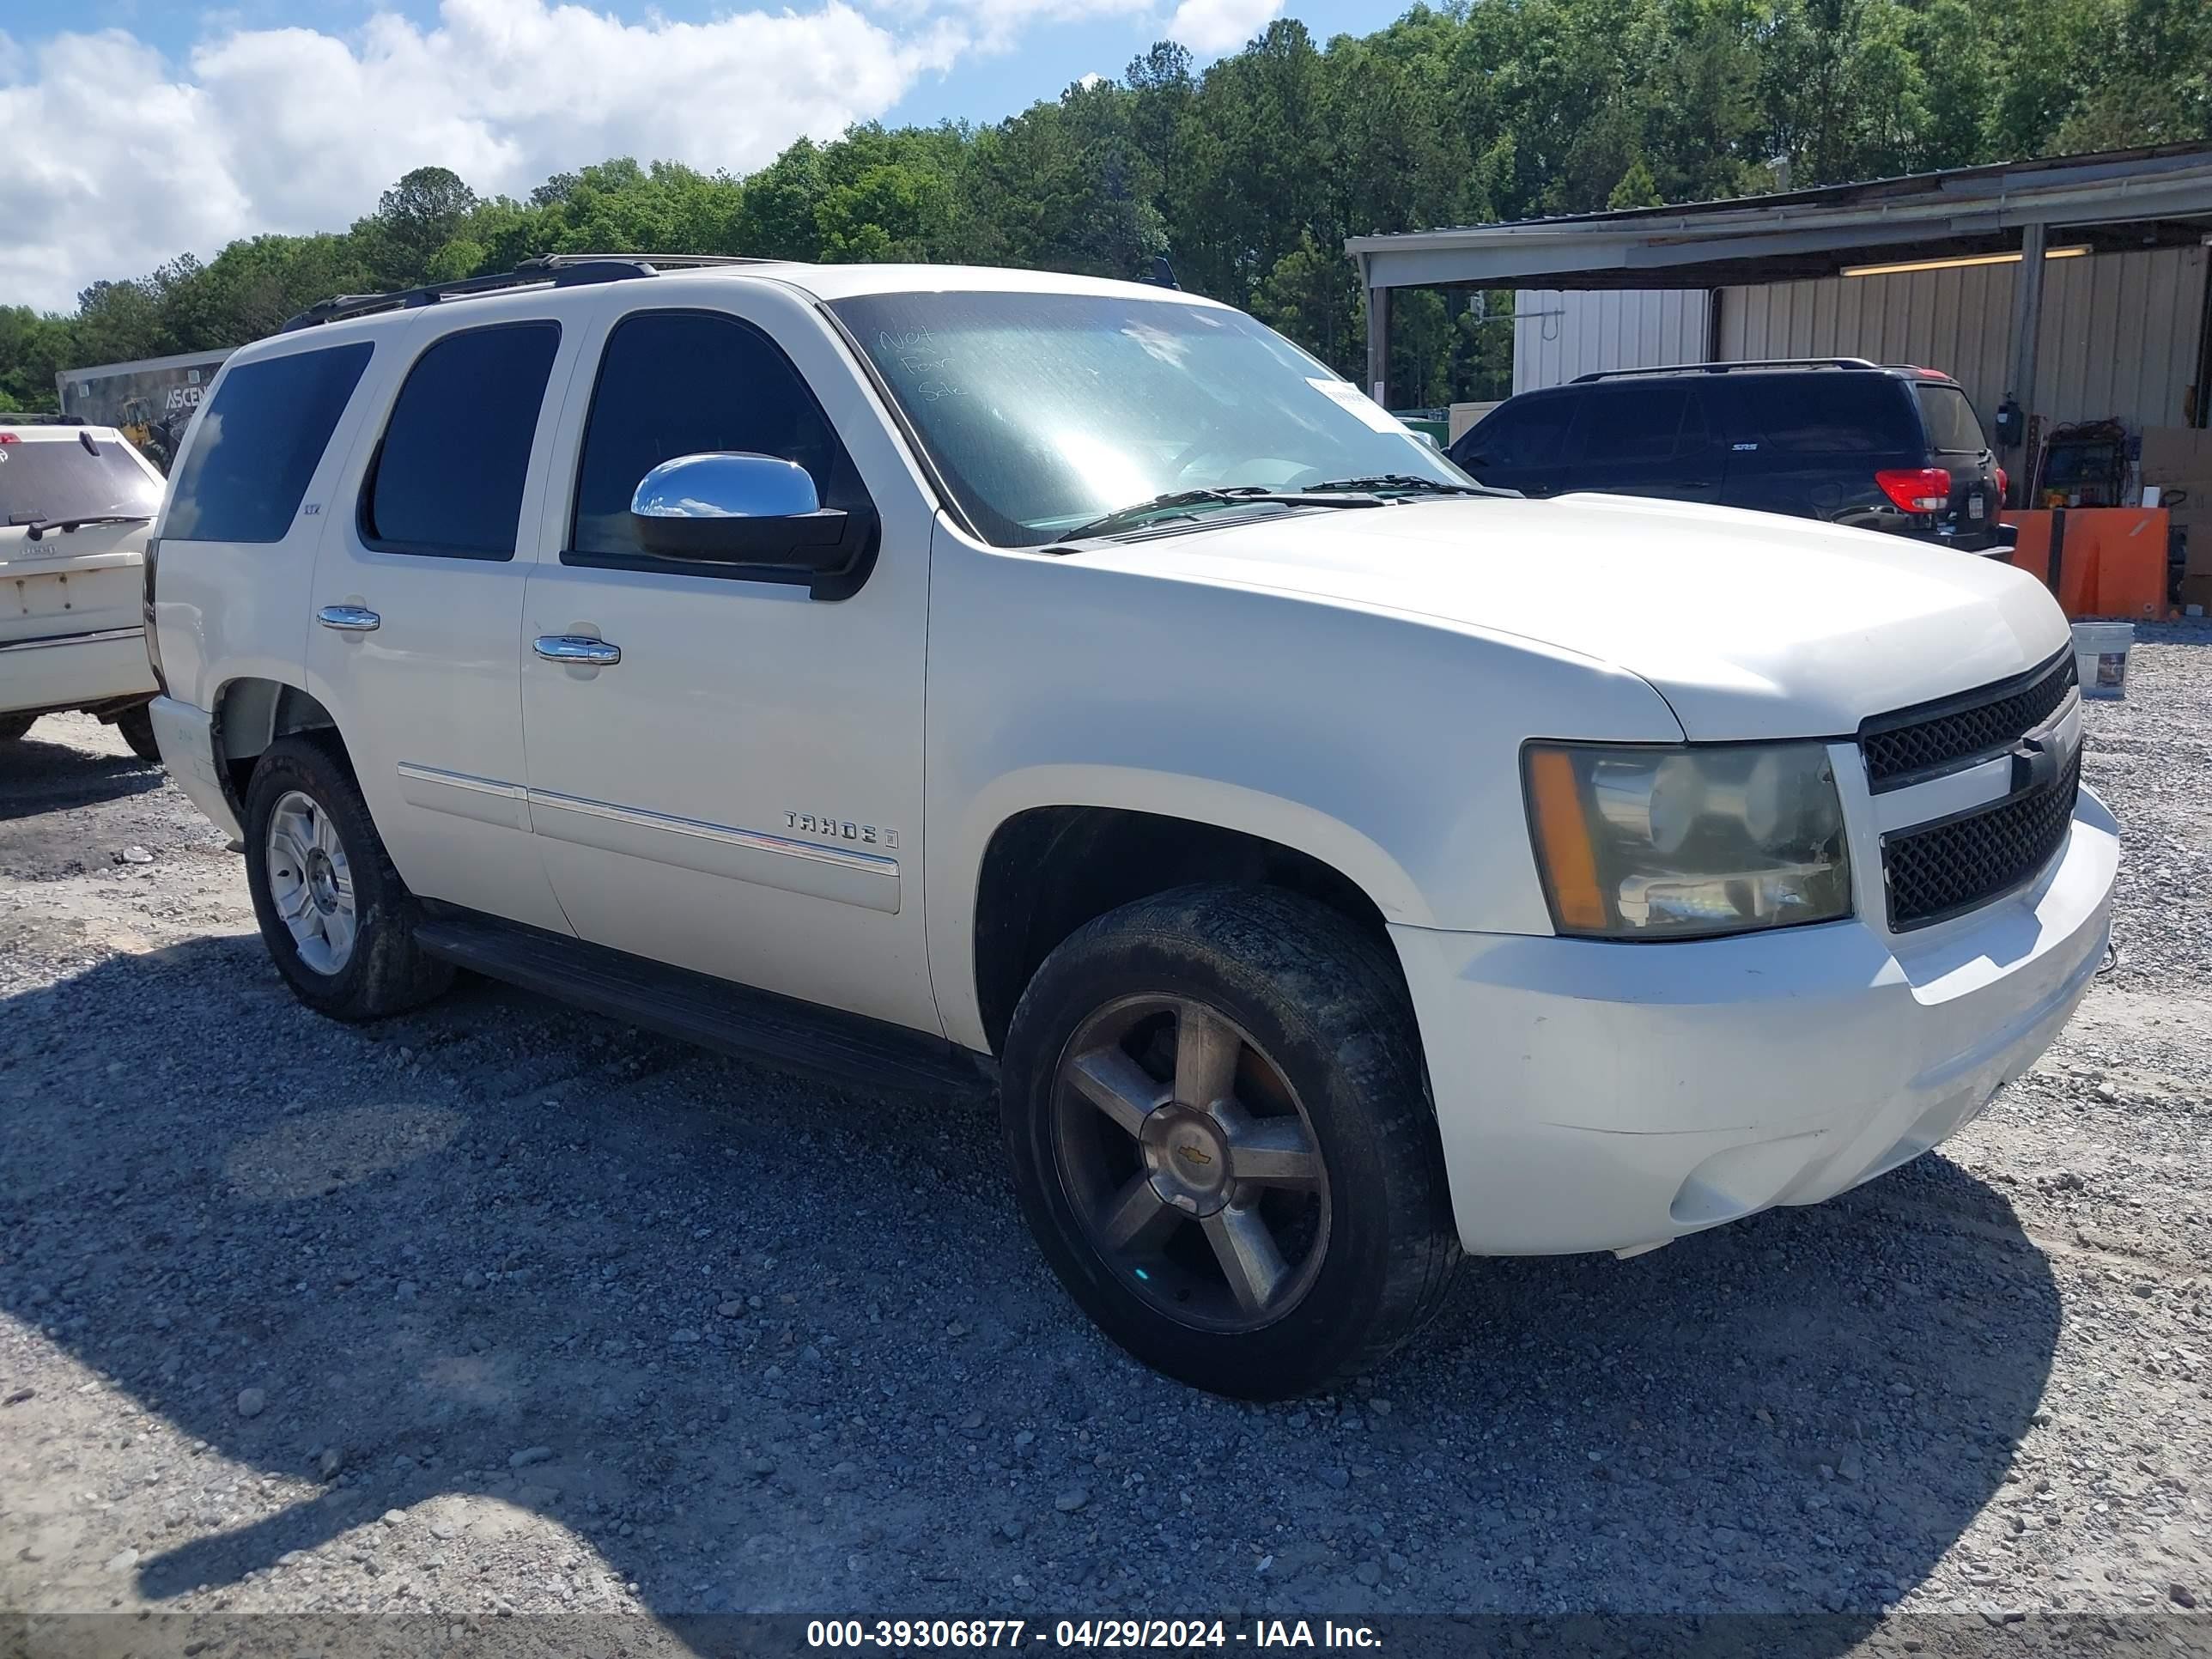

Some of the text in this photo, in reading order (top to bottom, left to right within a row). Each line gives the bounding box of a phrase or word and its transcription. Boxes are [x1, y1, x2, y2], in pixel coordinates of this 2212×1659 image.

[879, 325, 934, 349] Not
[21, 544, 57, 556] Jeep
[783, 810, 878, 844] TAHOE
